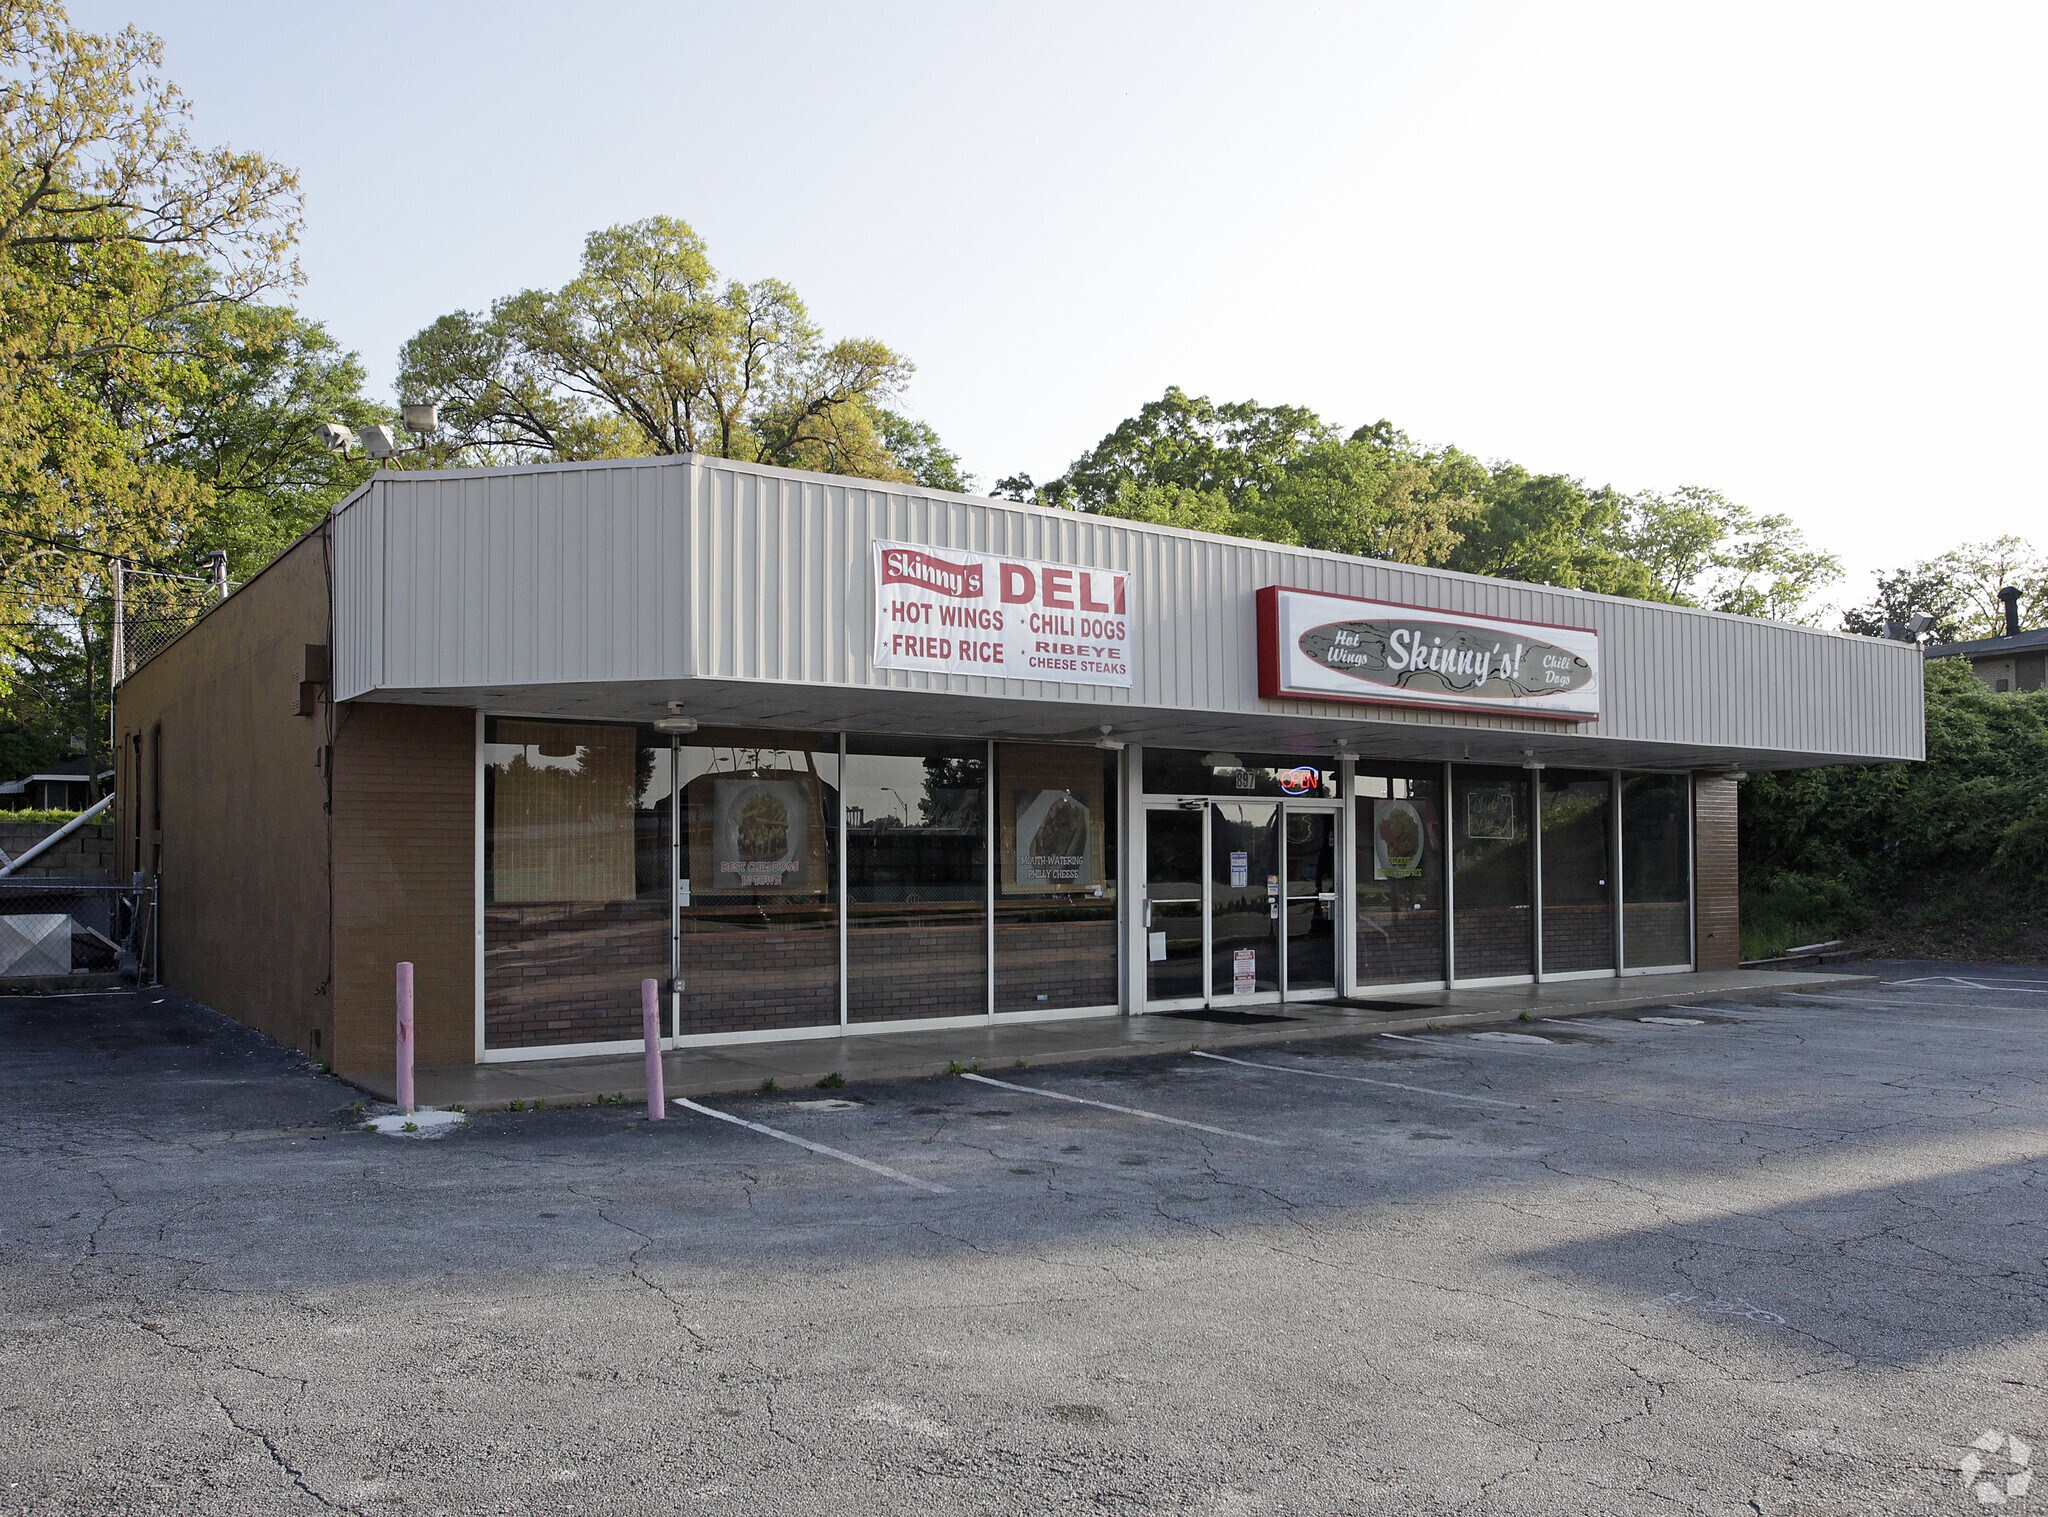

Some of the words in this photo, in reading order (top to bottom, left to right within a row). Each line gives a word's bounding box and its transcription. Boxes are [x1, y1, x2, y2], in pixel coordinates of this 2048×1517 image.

[887, 552, 981, 596] Skinny's
[999, 562, 1127, 616] DELI
[891, 600, 933, 624] HOT
[939, 605, 1005, 632] WINGS
[1029, 613, 1075, 637] CHILI
[1080, 617, 1127, 641] DOGS
[1334, 630, 1360, 648] Hot
[892, 634, 952, 660] FRIED
[958, 639, 1005, 664] RICE
[1035, 641, 1122, 660] RIBEYE
[1327, 646, 1369, 667] Wings
[1029, 656, 1077, 671] CHEESE
[1080, 660, 1127, 676] STEAKS
[1542, 654, 1571, 670] Chili
[1545, 670, 1571, 687] Dogs
[1236, 772, 1255, 788] 897
[1280, 771, 1318, 789] OPEN
[721, 861, 746, 872] BEST
[747, 861, 771, 872] CHILI
[772, 861, 799, 872] DOGS
[1028, 869, 1051, 879] PHILLY
[1052, 869, 1079, 879] CHEESE
